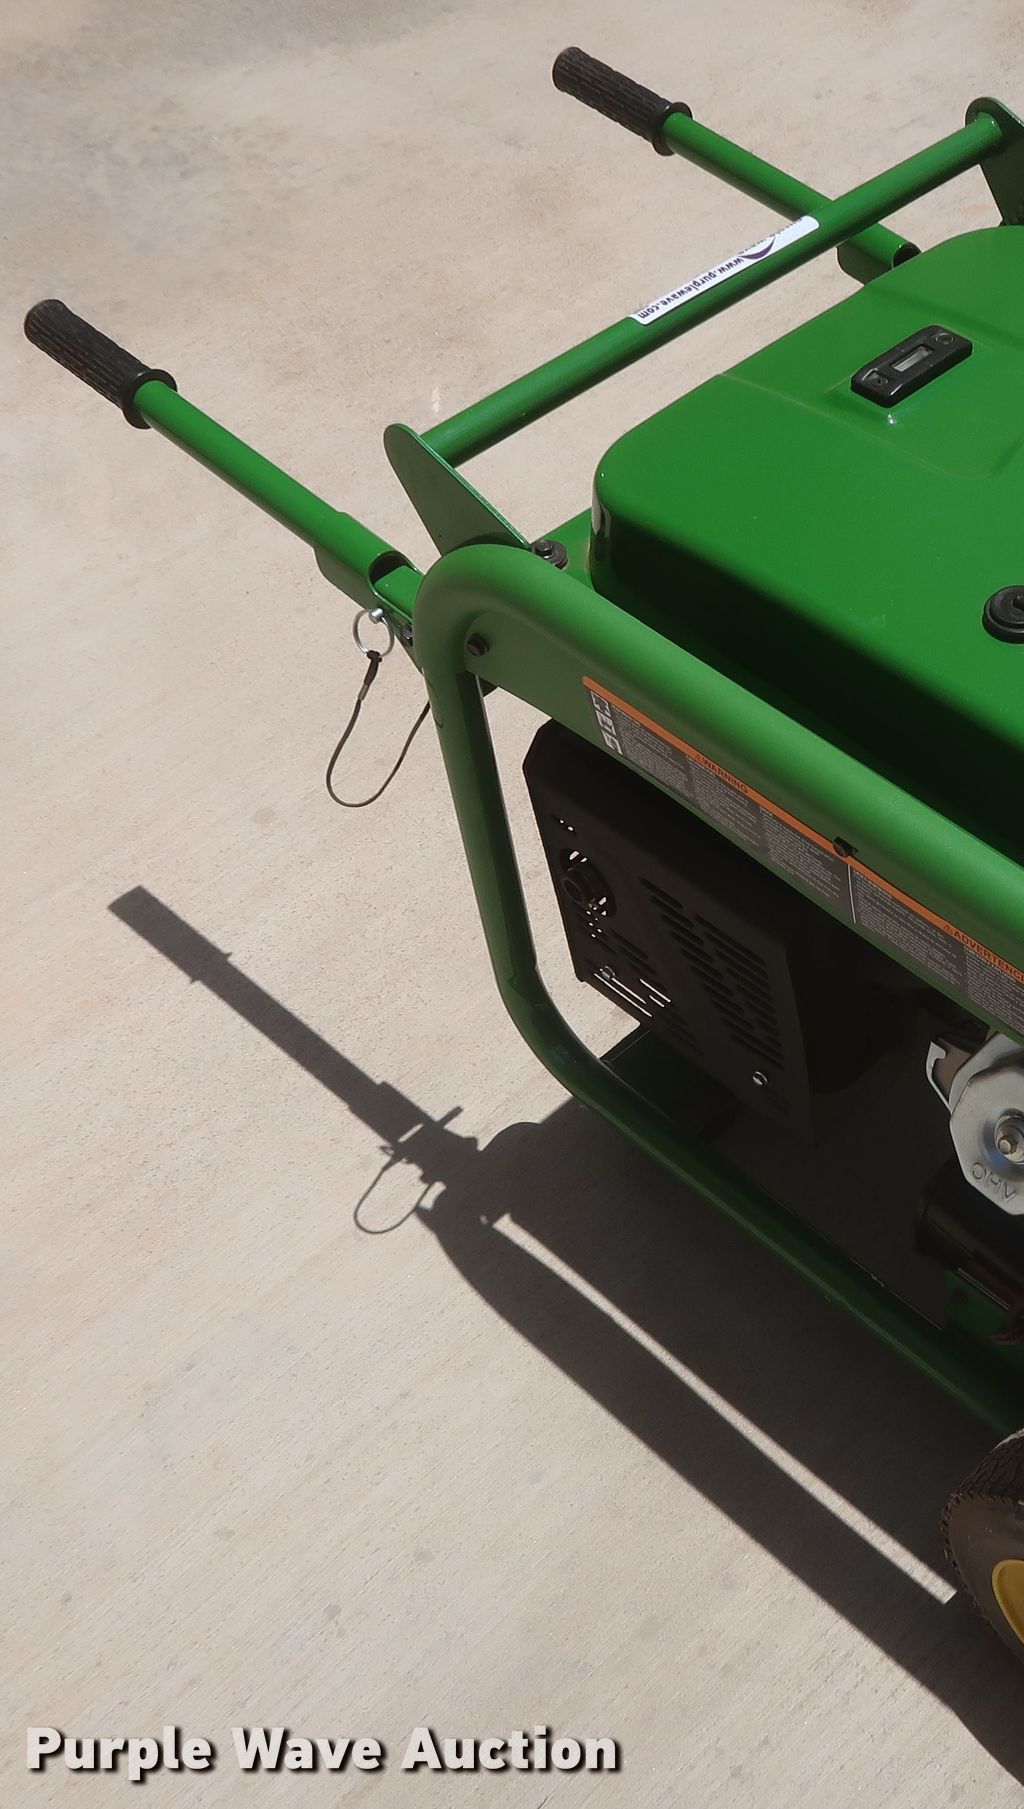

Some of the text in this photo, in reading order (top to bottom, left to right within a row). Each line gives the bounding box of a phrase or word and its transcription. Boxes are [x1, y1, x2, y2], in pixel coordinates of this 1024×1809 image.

[638, 256, 745, 320] www.purplewave.com
[703, 758, 749, 794] WARNING
[970, 1161, 1017, 1202] OHV
